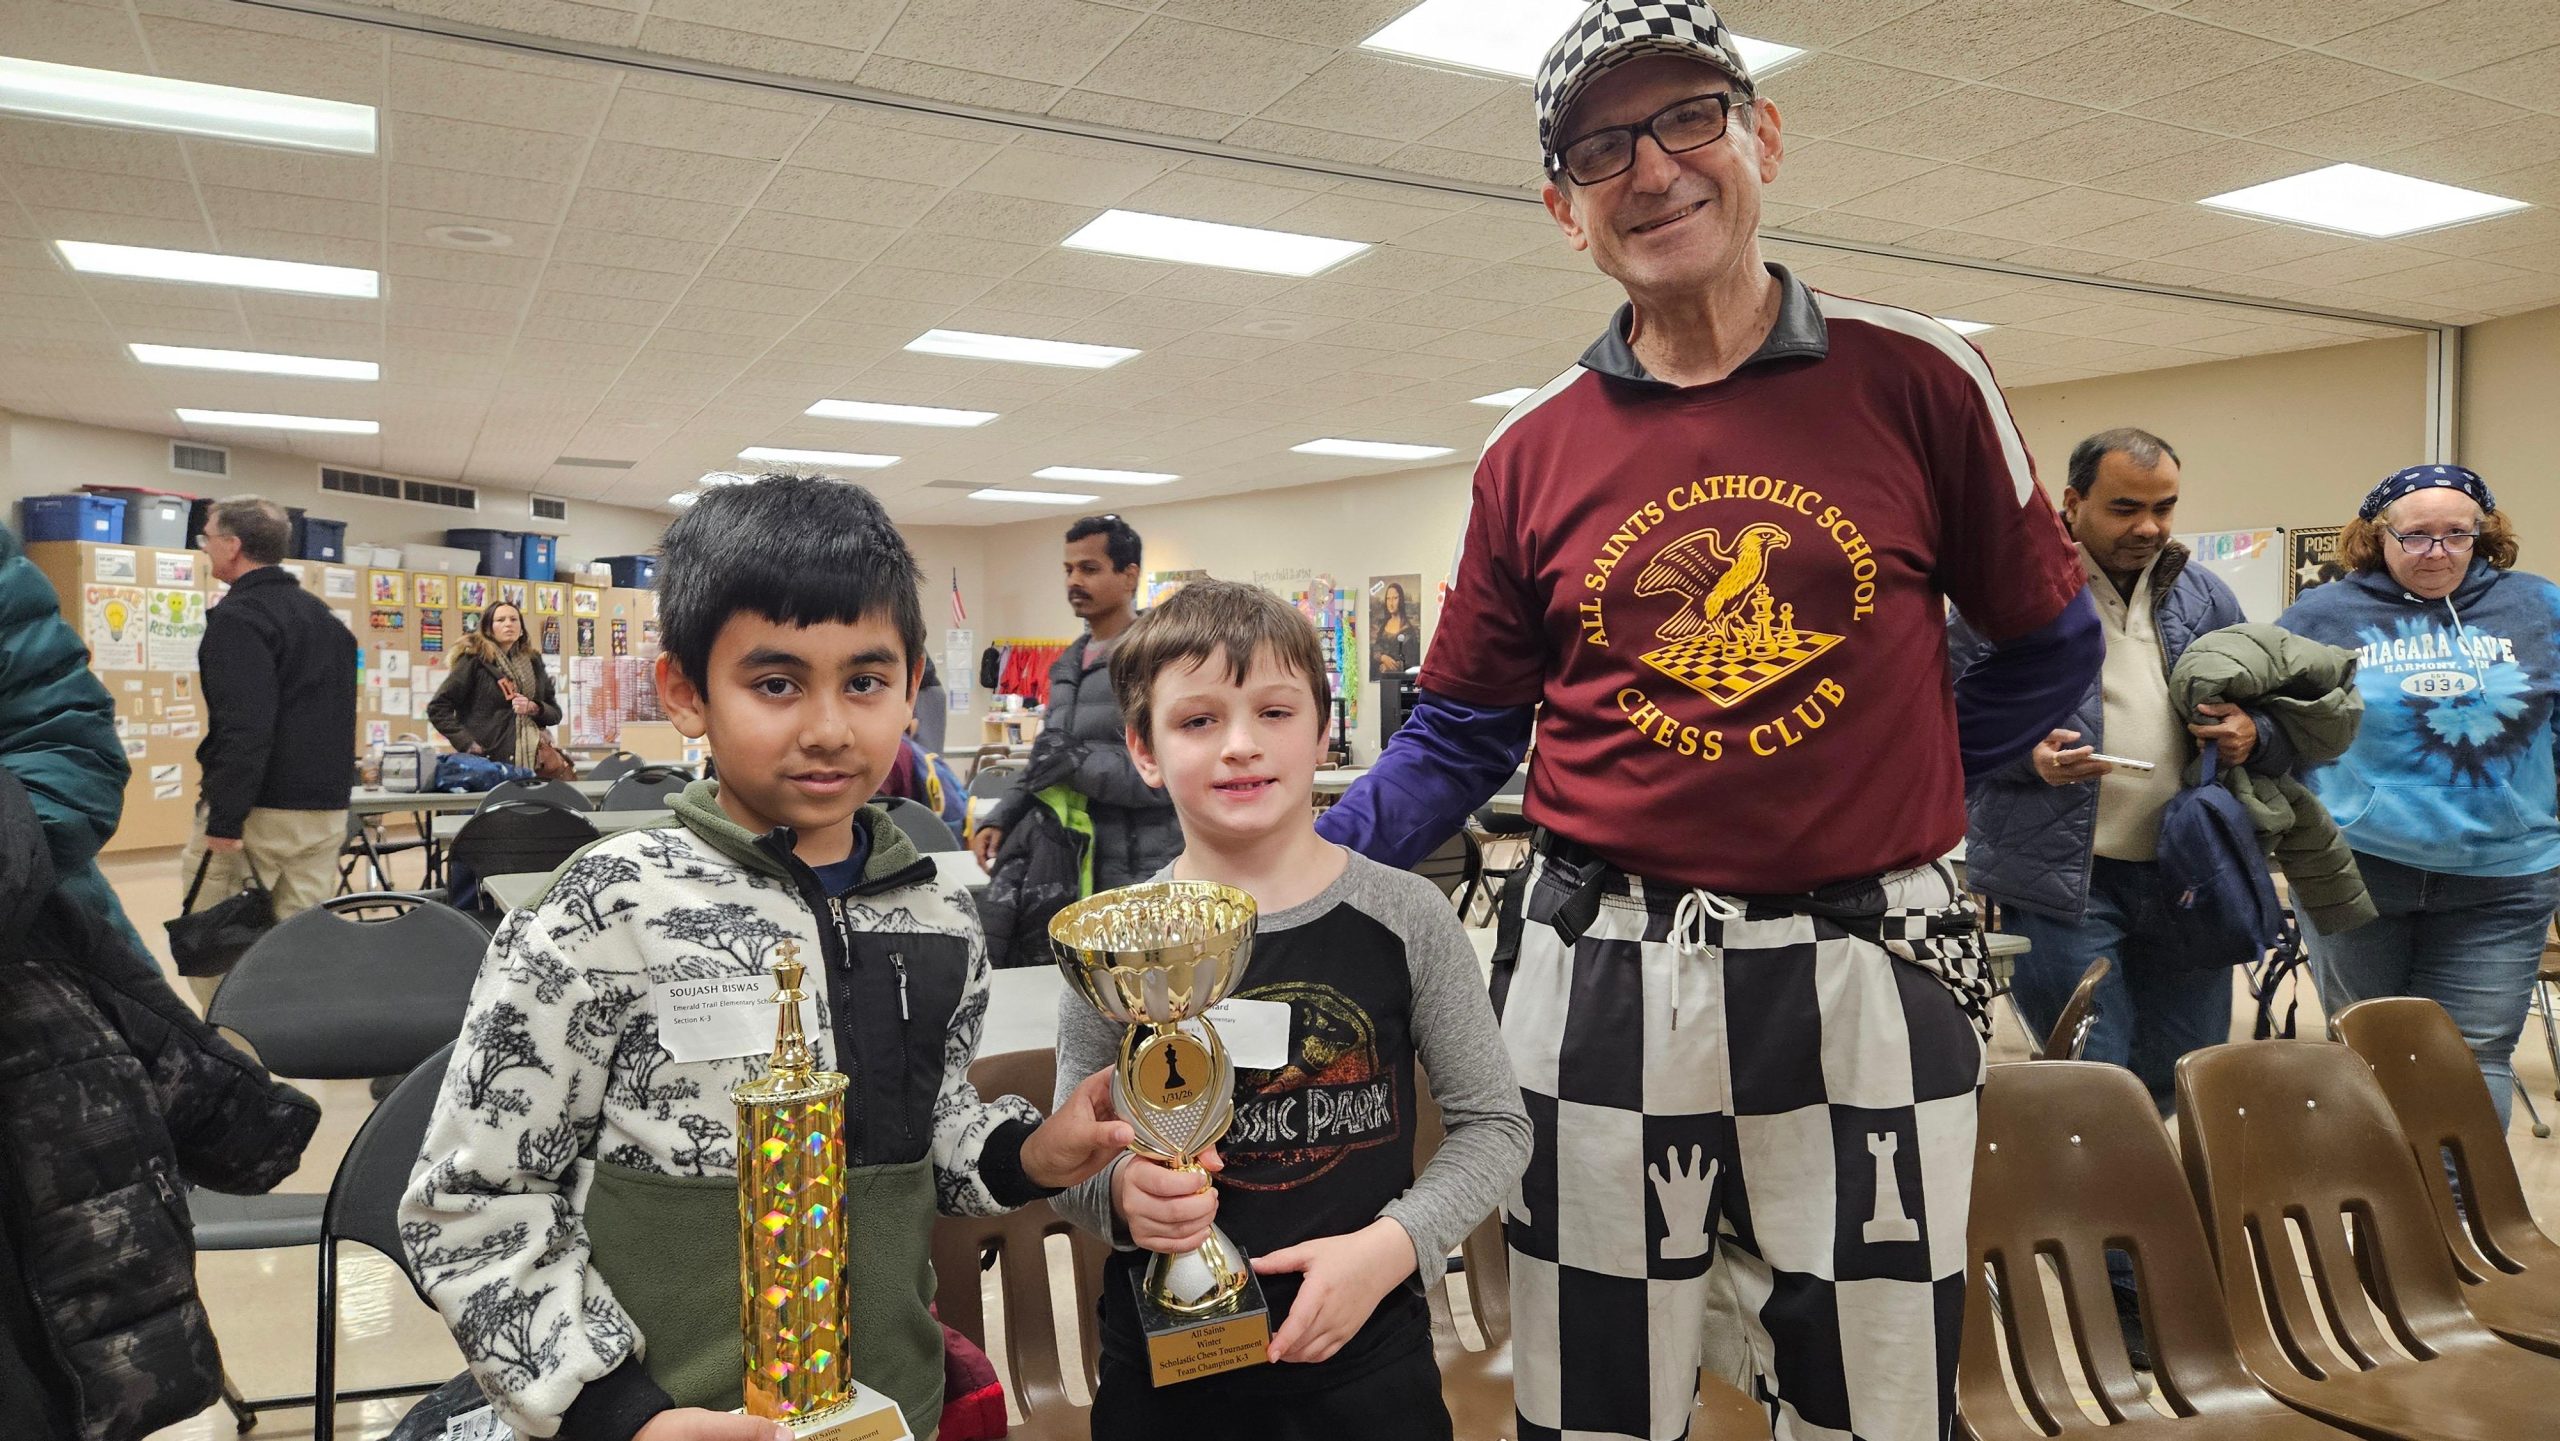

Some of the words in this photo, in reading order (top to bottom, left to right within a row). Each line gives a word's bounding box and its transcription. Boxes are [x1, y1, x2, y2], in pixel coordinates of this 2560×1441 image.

[1667, 475, 1823, 516] CATHOLIC
[1584, 501, 1665, 592] SAINTS
[1816, 505, 1877, 621] SCHOOL
[1580, 597, 1609, 648] ALL
[2355, 633, 2452, 670] NIAGARA
[2457, 635, 2517, 664] CAVE
[2413, 678, 2465, 693] 1934
[1616, 688, 1723, 761] CHESS
[1750, 677, 1846, 756] CLUB
[670, 985, 719, 998] SOUJASH
[722, 982, 760, 993] BISWAS
[673, 1002, 700, 1012] Emerald
[702, 1001, 718, 1009] Trail
[720, 998, 755, 1008] Elementary
[674, 1016, 698, 1025] Section
[700, 1014, 712, 1023] K-3
[1161, 1088, 1194, 1104] 1/31/26
[1306, 1083, 1391, 1144] PARK
[1191, 1329, 1203, 1339] All
[1203, 1325, 1226, 1337] Saints
[1196, 1337, 1222, 1350] Winter
[1159, 1354, 1196, 1370] Scholastic
[1196, 1349, 1218, 1362] Chess
[1219, 1339, 1262, 1354] Tournament
[1177, 1368, 1197, 1377] Team
[1197, 1358, 1235, 1373] Champion
[1235, 1352, 1249, 1363] K-3
[819, 1427, 842, 1438] Saints
